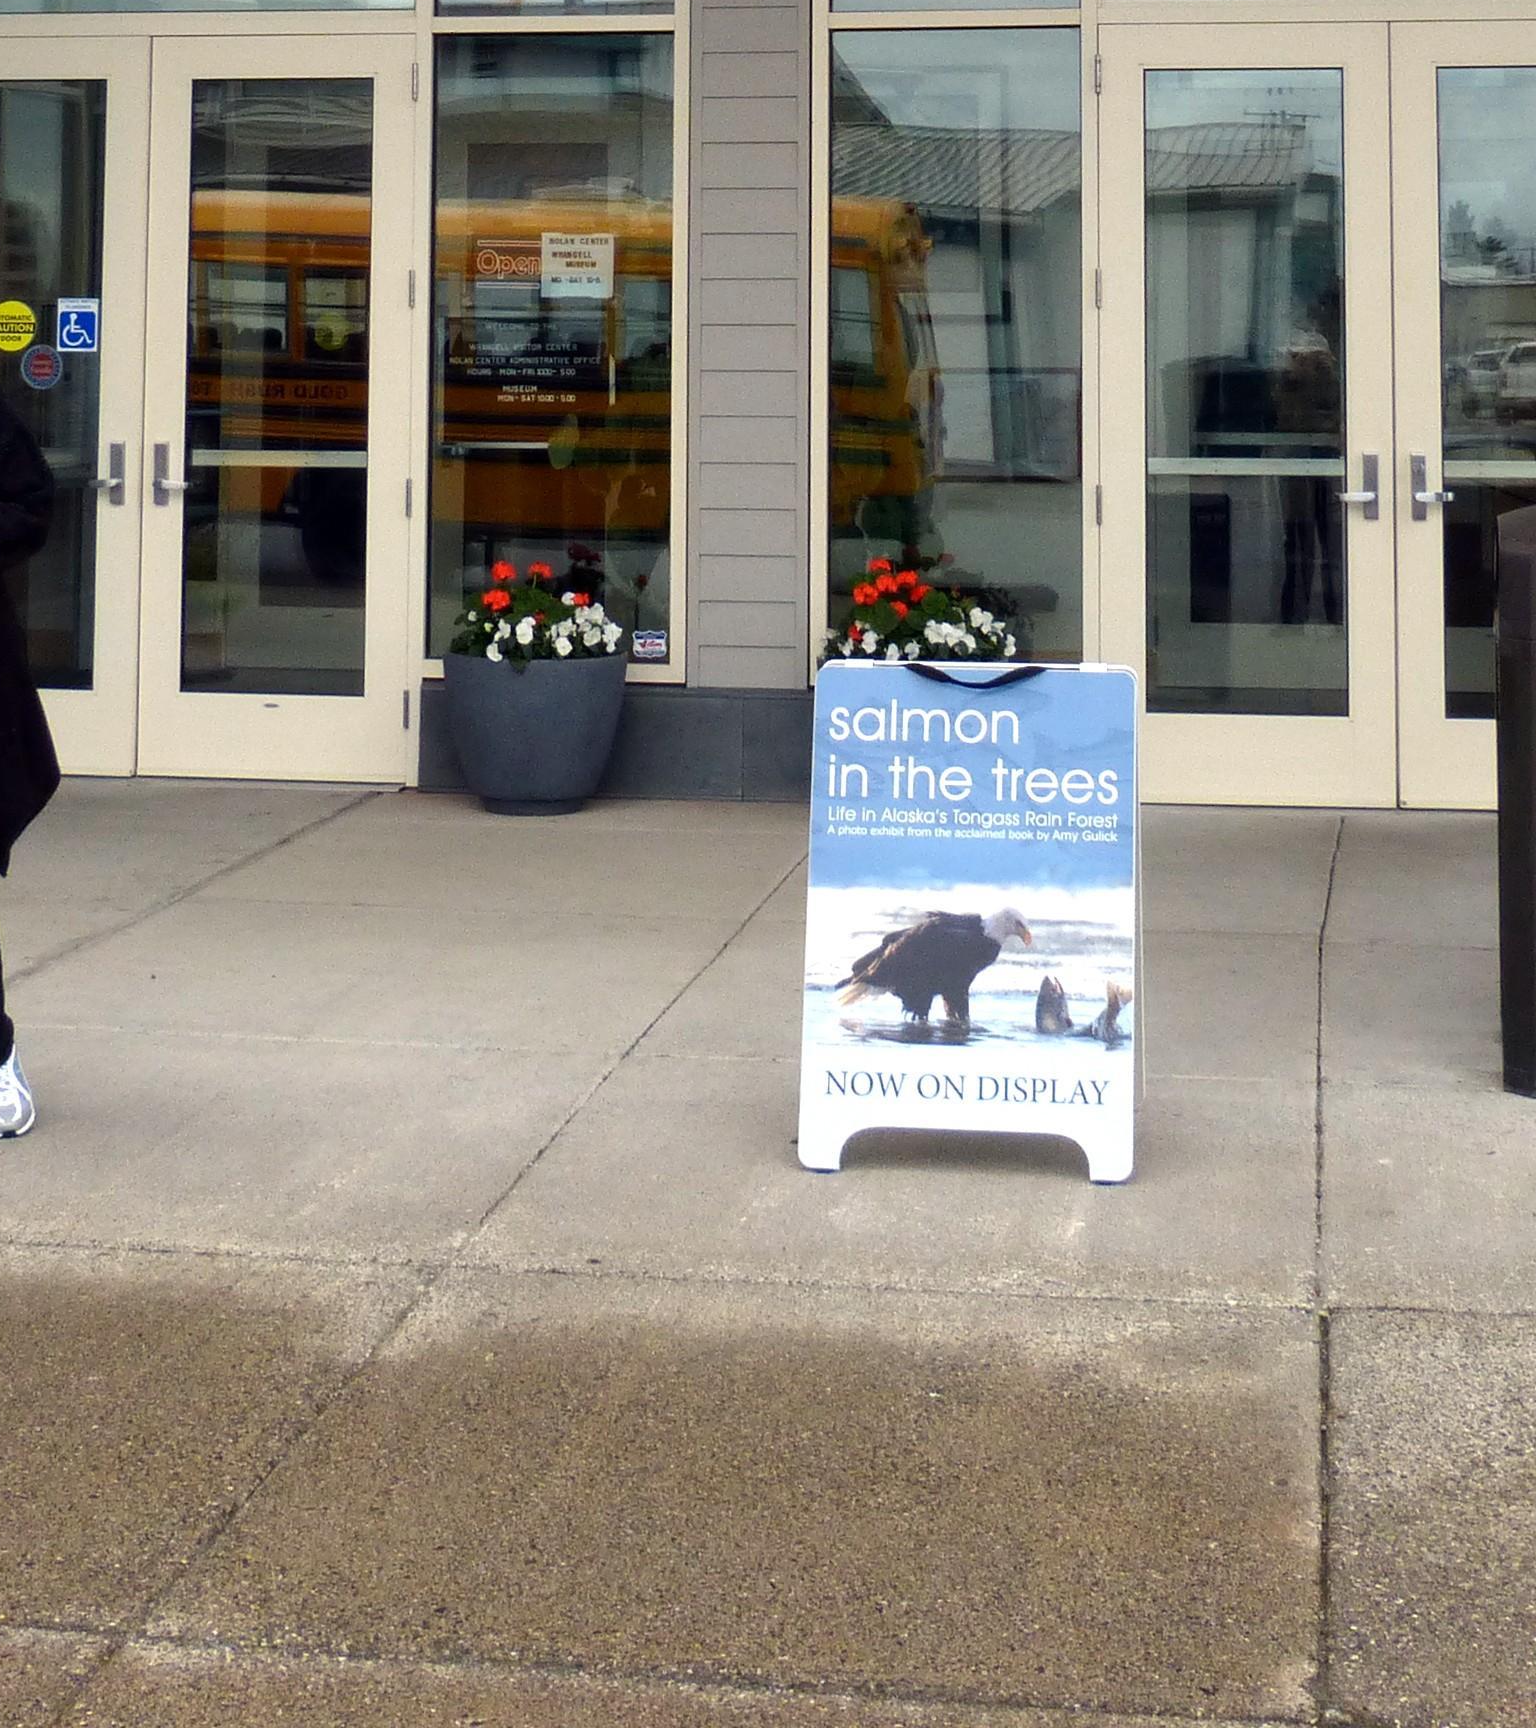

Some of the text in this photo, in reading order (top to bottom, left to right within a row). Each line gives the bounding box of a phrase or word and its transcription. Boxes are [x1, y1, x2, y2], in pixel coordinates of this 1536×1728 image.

[477, 249, 541, 280] Open
[828, 698, 1020, 744] salmon
[827, 754, 1119, 805] in the trees
[826, 824, 1118, 844] A photo exhibit from the acclaimed book by Amy Gulick
[827, 806, 1119, 829] Life in Alaska's Tongass Rain Forest
[825, 1069, 1111, 1106] NOW ON DISPLAY
